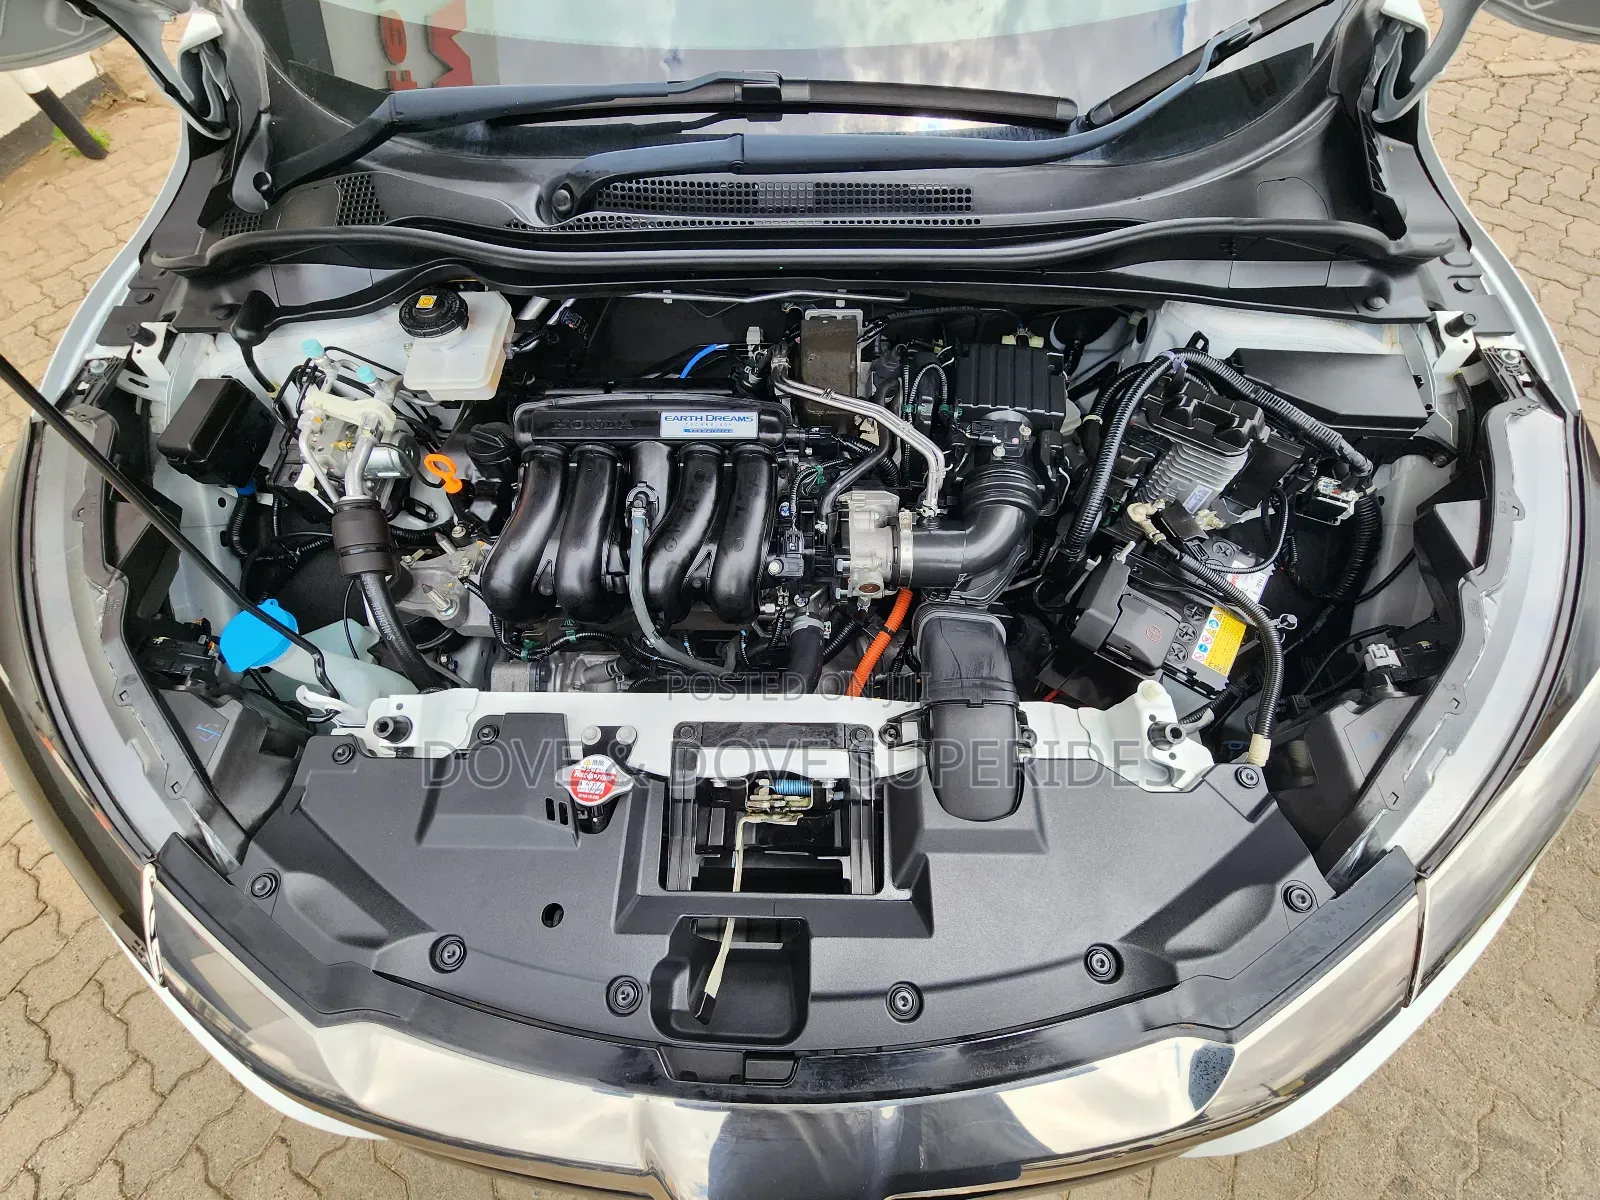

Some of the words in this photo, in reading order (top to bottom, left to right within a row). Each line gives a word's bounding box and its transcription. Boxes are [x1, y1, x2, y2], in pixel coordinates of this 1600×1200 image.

[664, 414, 703, 422] EARTH
[705, 414, 754, 422] DREAMS
[552, 419, 635, 430] HONDA
